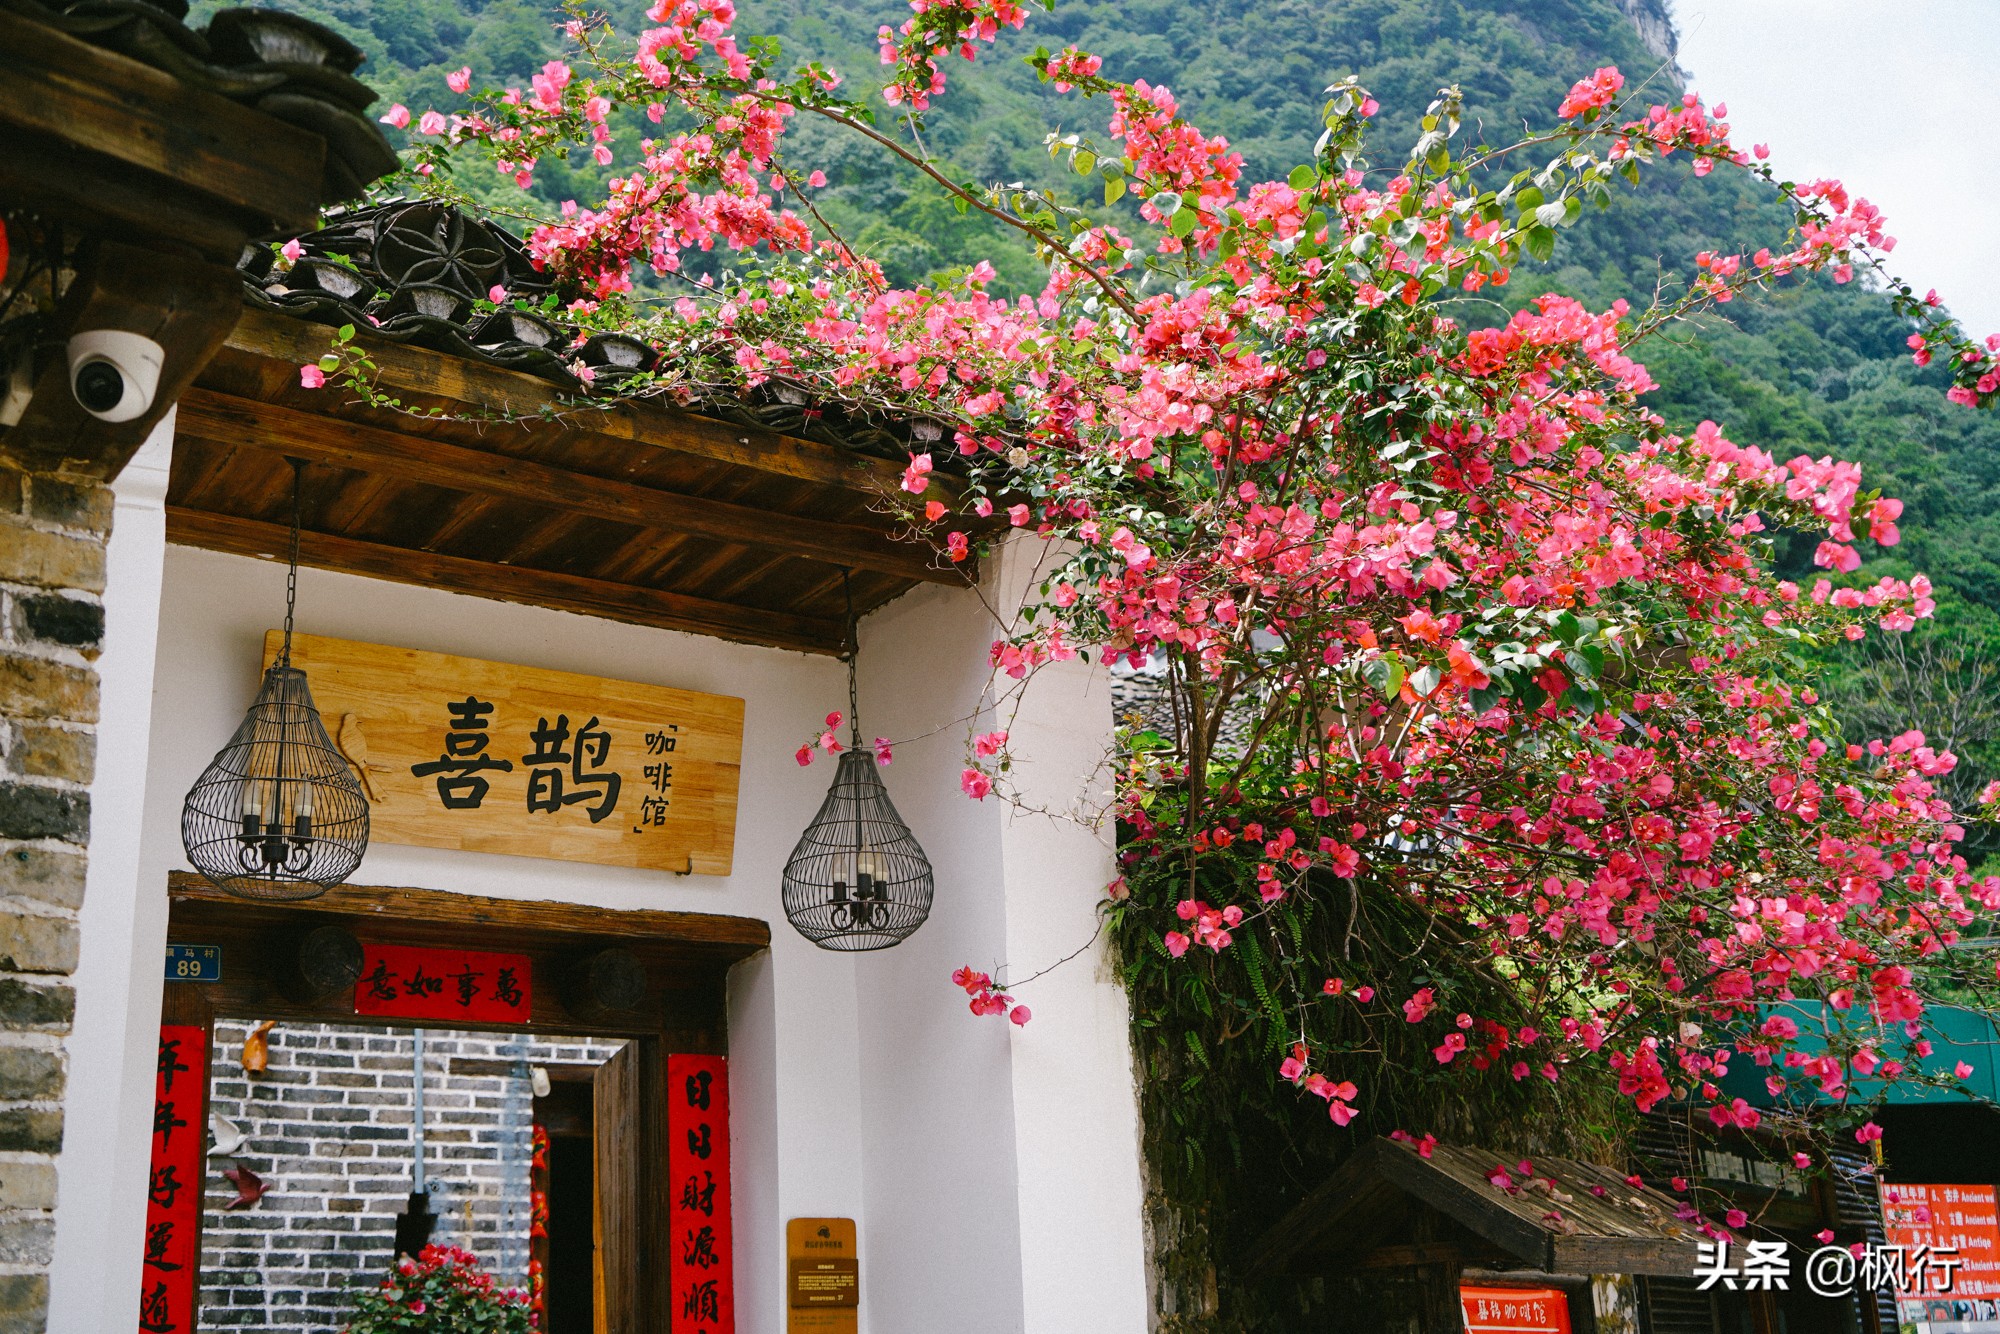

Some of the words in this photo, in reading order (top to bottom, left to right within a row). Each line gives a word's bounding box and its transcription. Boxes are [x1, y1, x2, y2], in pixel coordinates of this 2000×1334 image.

[411, 696, 621, 823] 喜鹊
[177, 960, 201, 977] 89
[360, 959, 523, 1006] 萬事如意
[680, 1070, 719, 1334] 日日財源順
